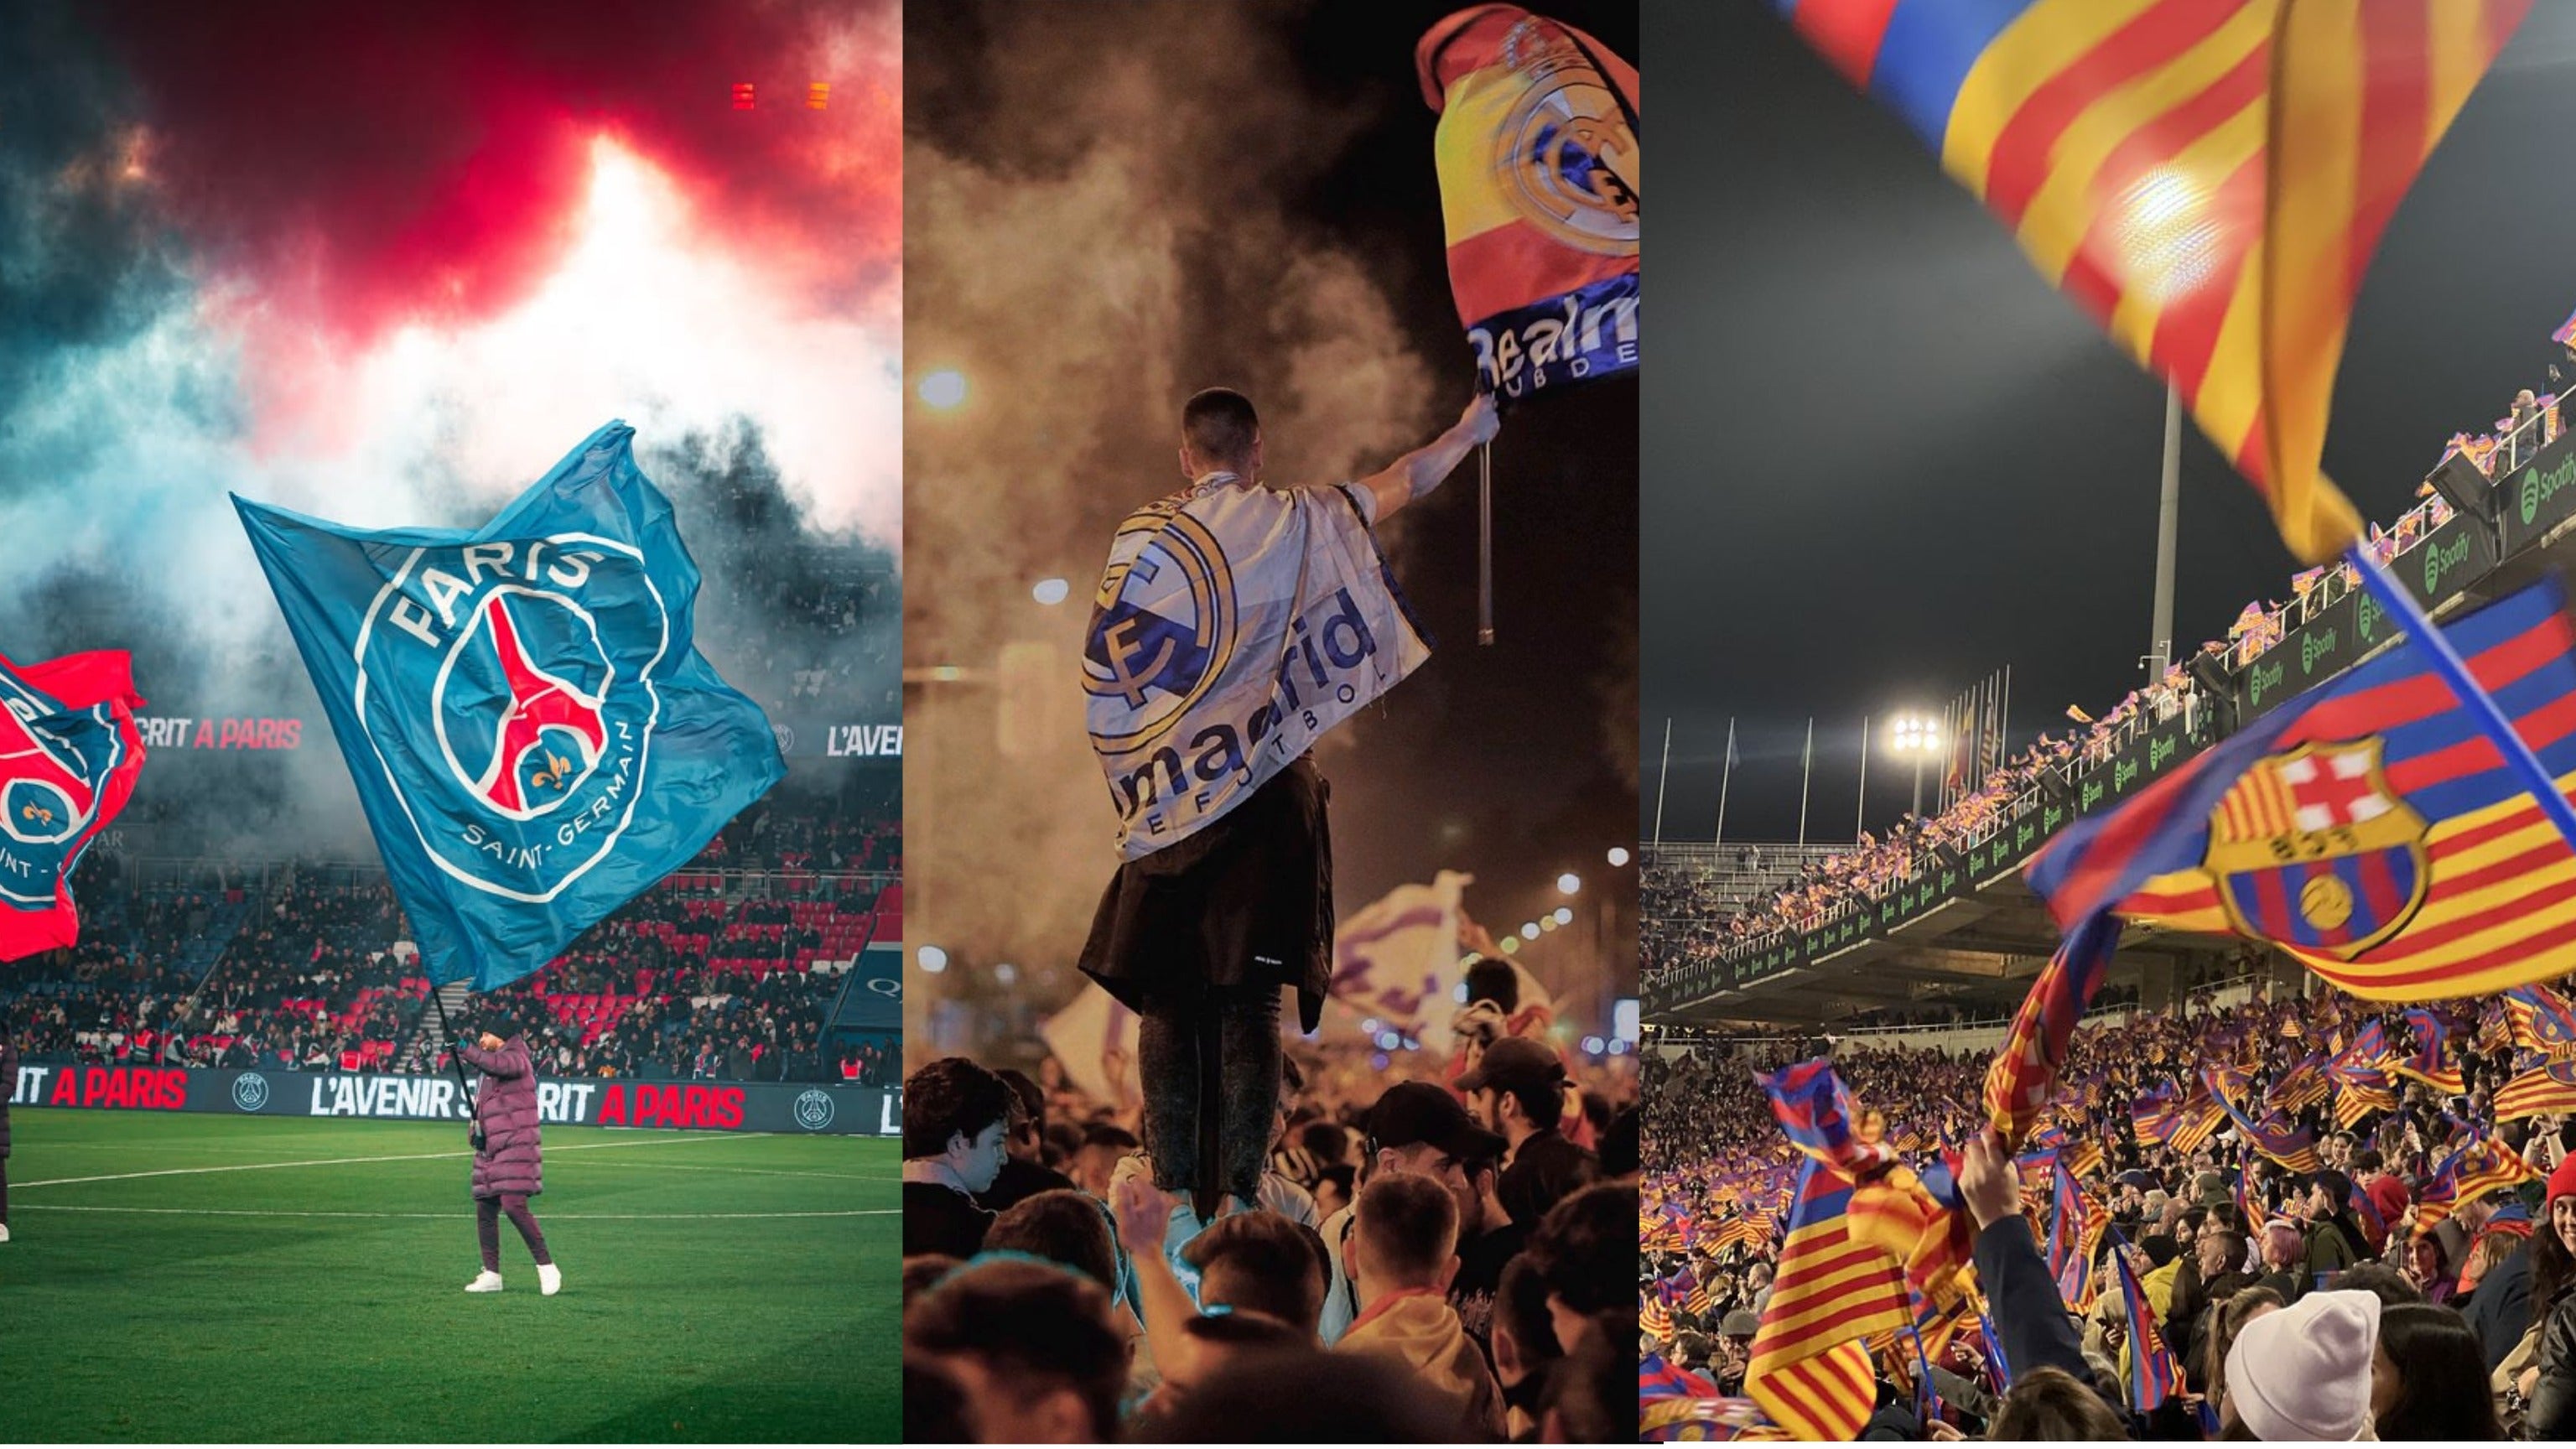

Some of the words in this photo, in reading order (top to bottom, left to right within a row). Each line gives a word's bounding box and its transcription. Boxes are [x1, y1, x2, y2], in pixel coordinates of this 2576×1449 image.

[389, 542, 605, 648] PARIS
[193, 719, 215, 749] A
[219, 719, 303, 749] PARIS
[462, 721, 633, 870] SAINT-GERMAIN
[9, 1067, 49, 1104] IT
[50, 1067, 77, 1106] A
[85, 1067, 188, 1109] PARIS
[310, 1077, 454, 1118] L'AVENIR
[598, 1084, 626, 1124] A
[633, 1085, 745, 1129] PARIS
